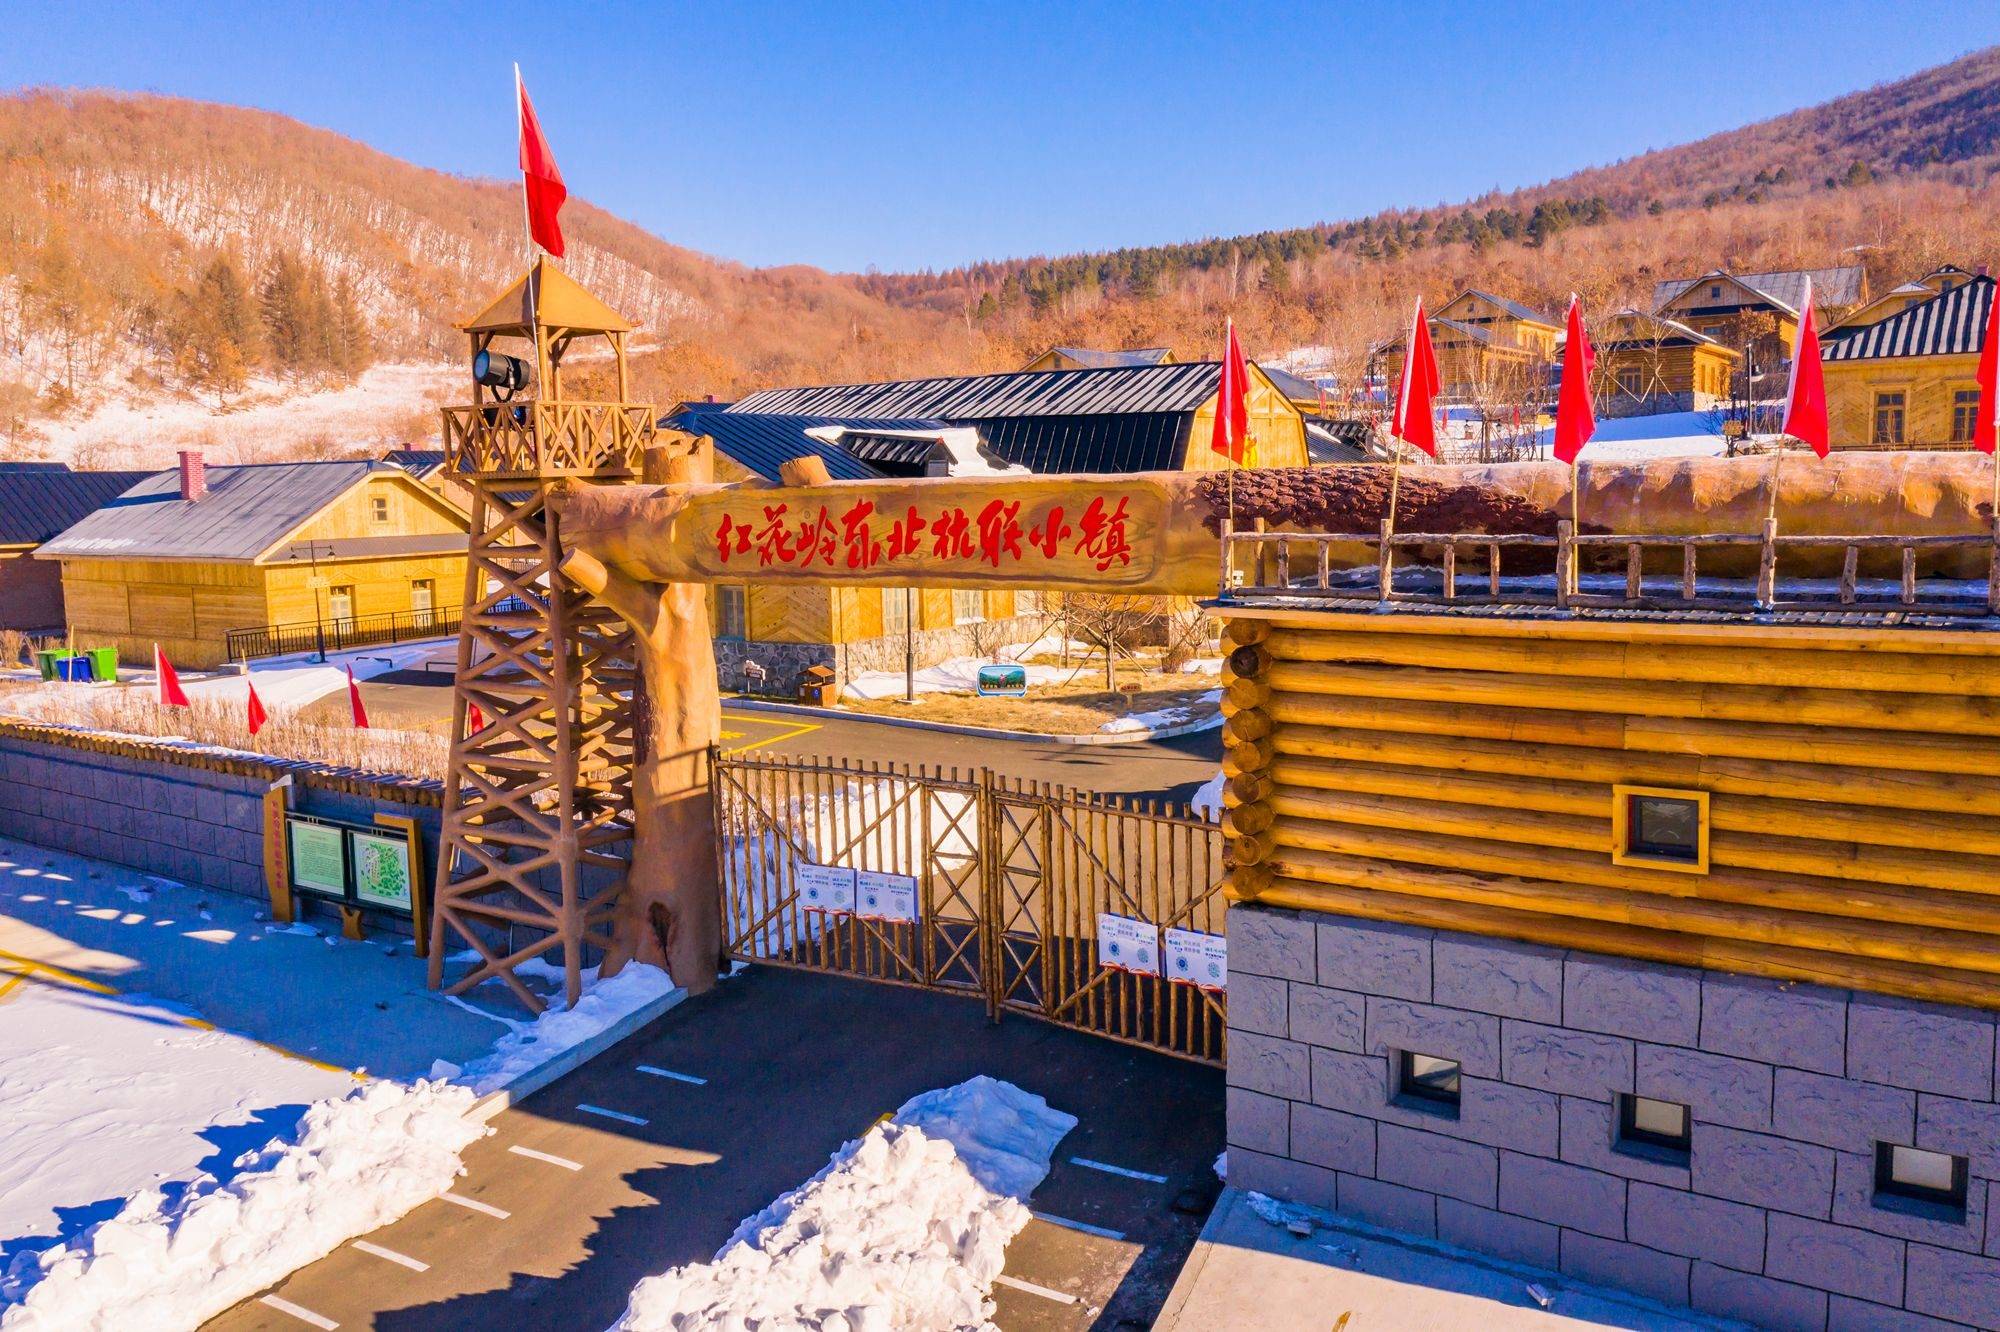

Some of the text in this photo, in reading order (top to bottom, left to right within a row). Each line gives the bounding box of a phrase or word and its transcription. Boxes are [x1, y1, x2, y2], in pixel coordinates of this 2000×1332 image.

[716, 496, 1131, 571] 红花岭东北抗联小镇
